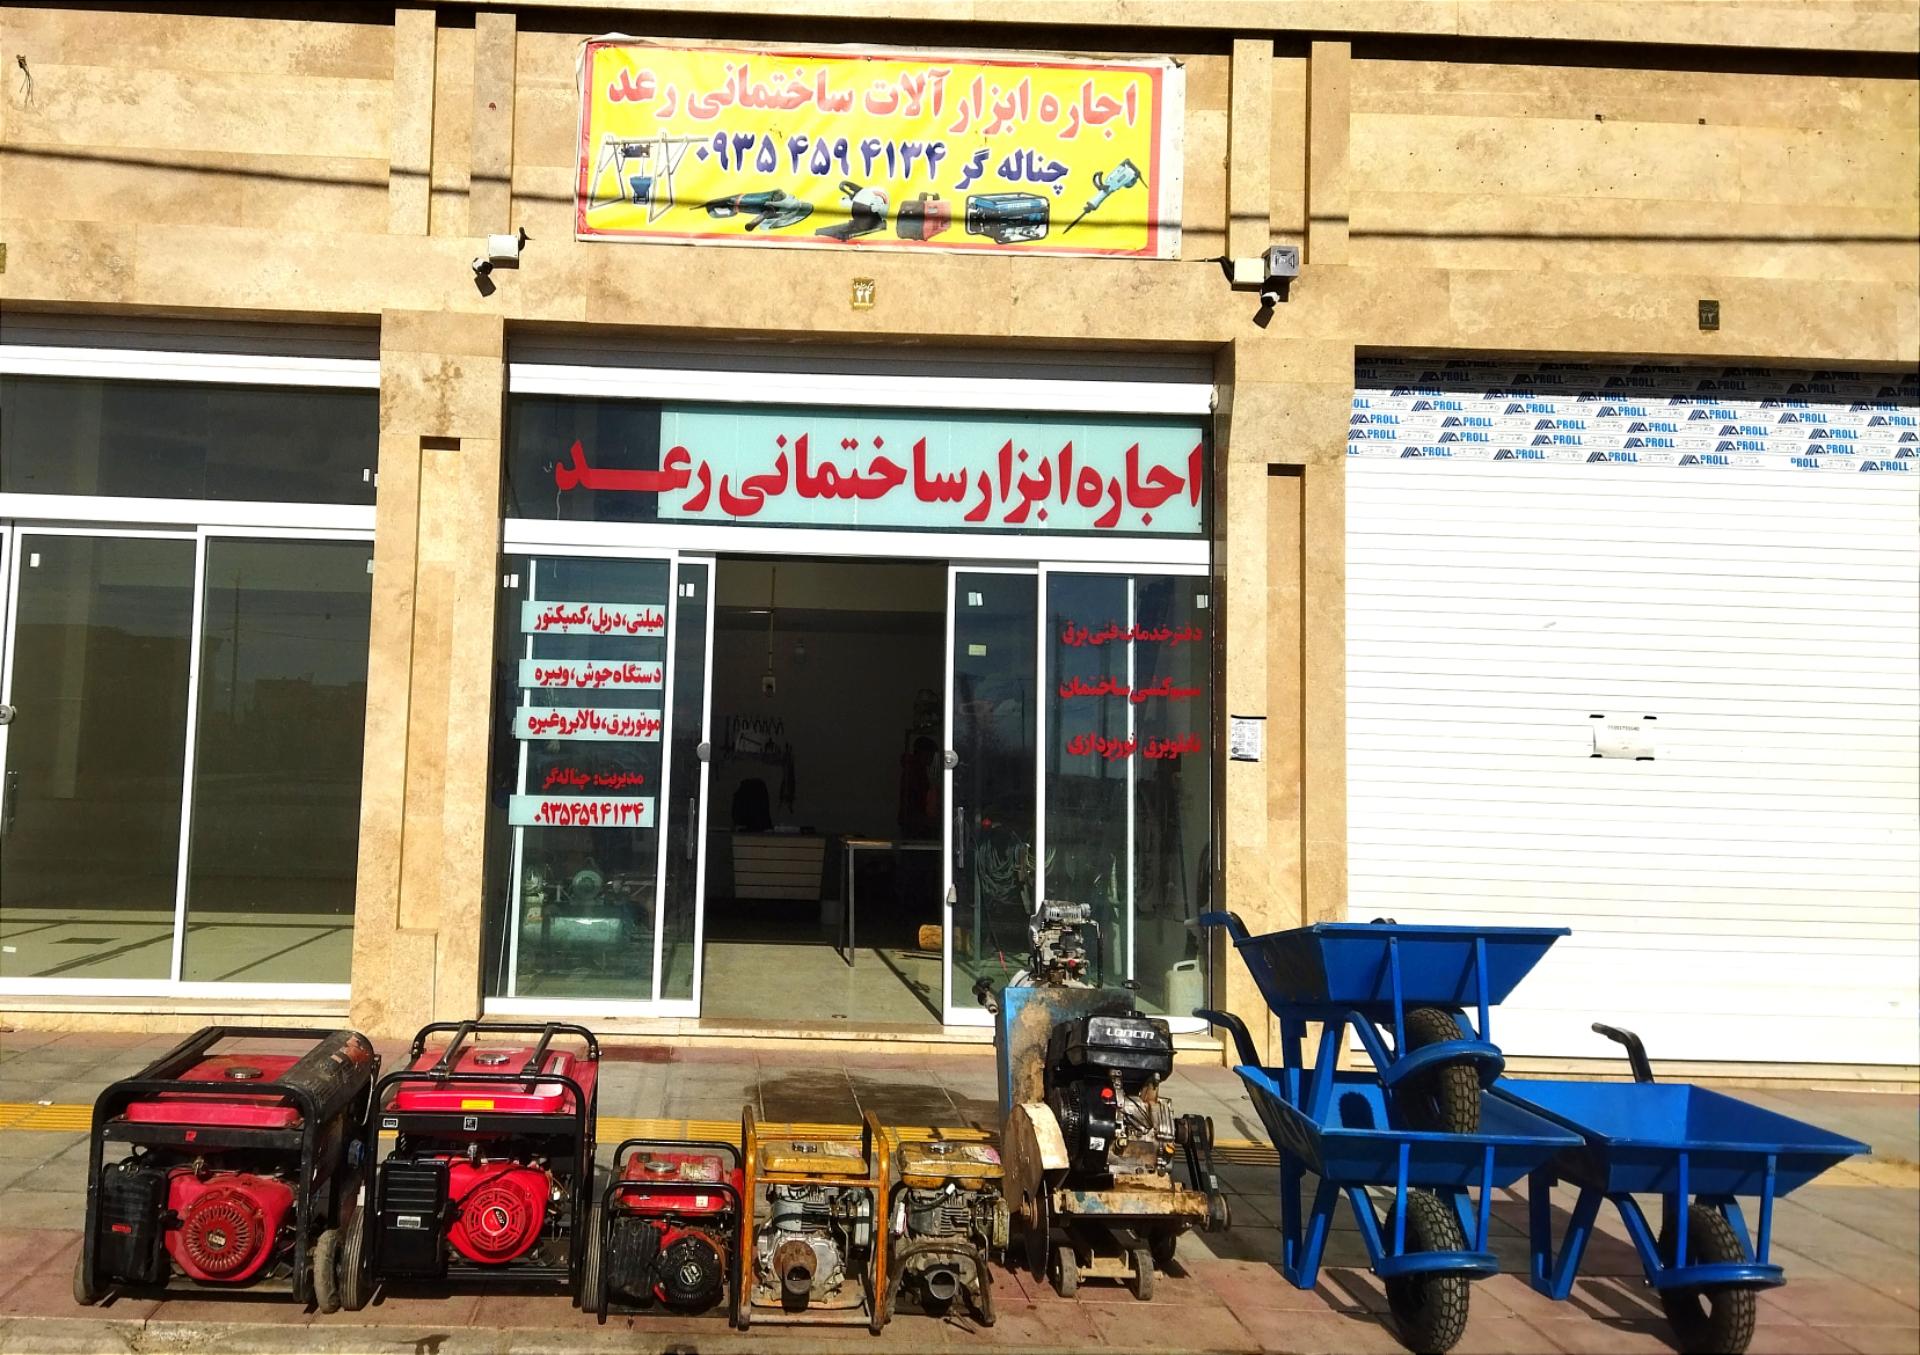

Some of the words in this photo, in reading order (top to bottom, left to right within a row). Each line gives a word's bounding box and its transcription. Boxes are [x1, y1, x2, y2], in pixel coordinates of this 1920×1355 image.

[608, 69, 677, 118] رعد
[687, 64, 854, 119] ساختمانی
[865, 69, 950, 117] آلات
[949, 75, 1031, 135] ابزار
[1040, 80, 1136, 139] اجاره
[696, 131, 777, 174] ۰۹۳۵
[787, 135, 850, 176] ۴۵۹
[860, 138, 946, 180] ۴۱۳۴
[954, 149, 990, 190] گر
[997, 149, 1069, 196] چناله
[555, 439, 712, 511] رعد
[719, 432, 968, 517] ساختمانی
[963, 438, 1073, 523] ابزار
[1076, 442, 1203, 528] اجاره
[534, 801, 645, 825] ۰۹۳۵۴۵۹۴۱۳۴
